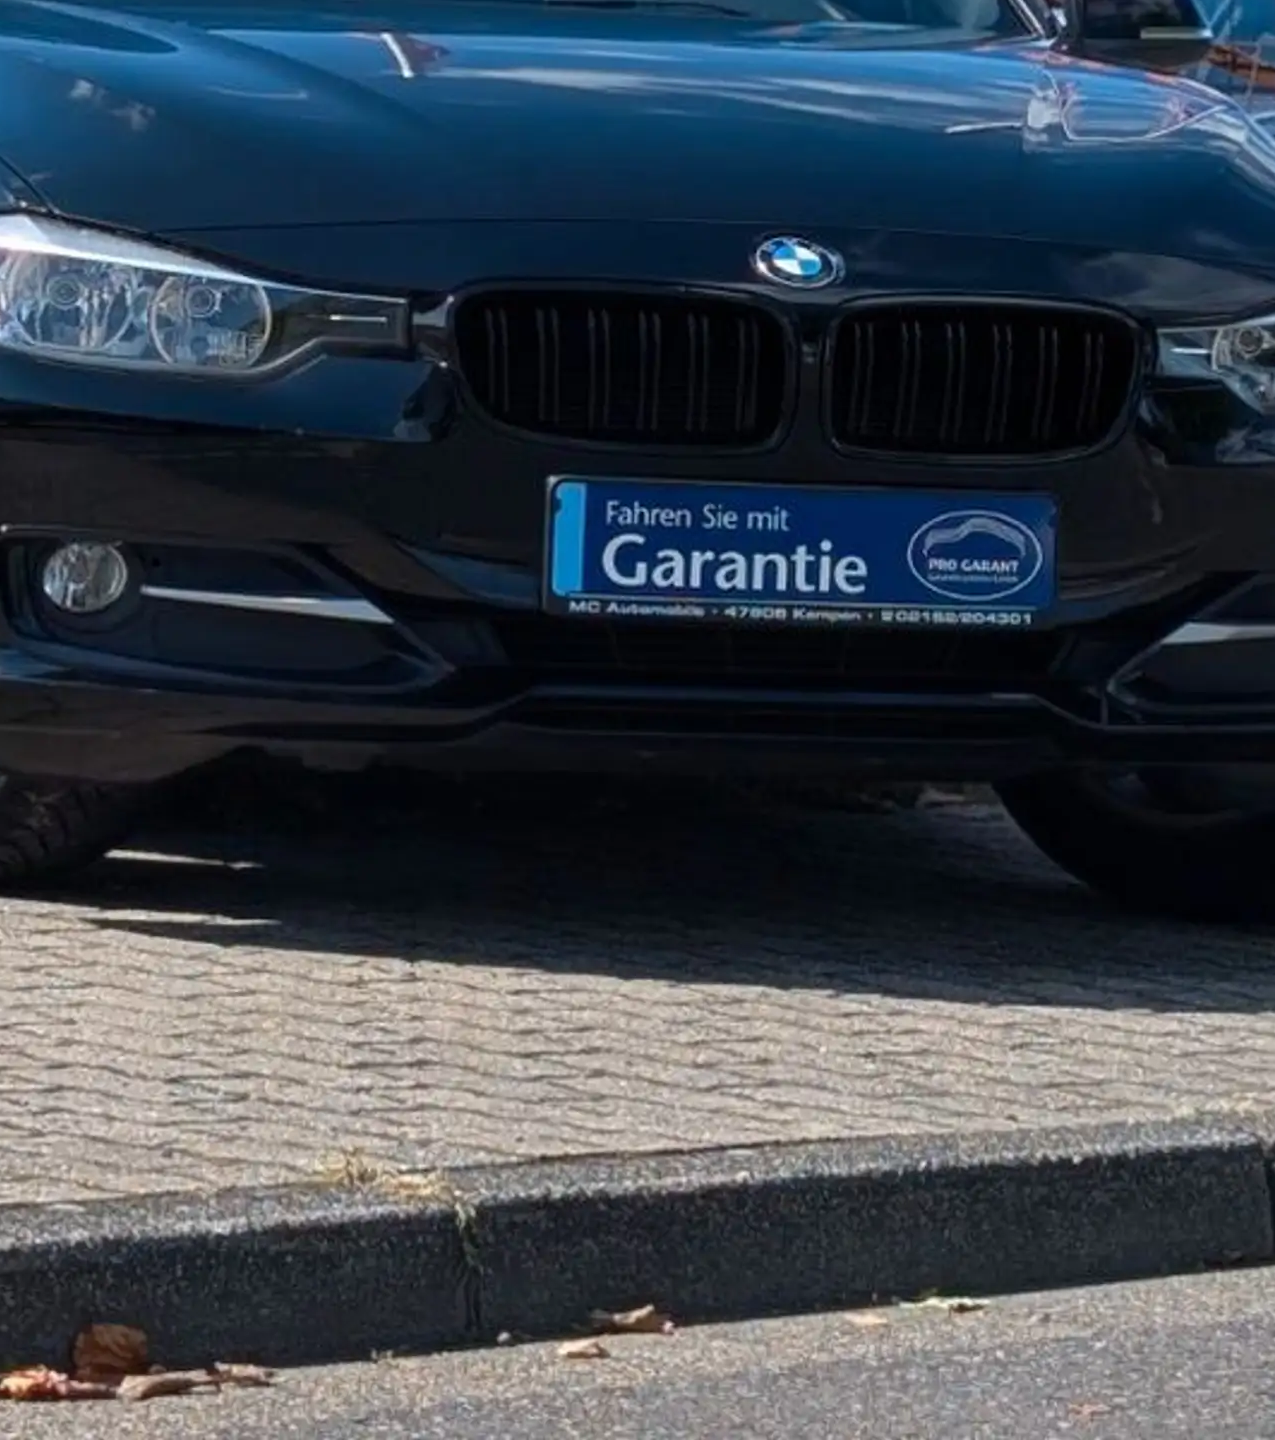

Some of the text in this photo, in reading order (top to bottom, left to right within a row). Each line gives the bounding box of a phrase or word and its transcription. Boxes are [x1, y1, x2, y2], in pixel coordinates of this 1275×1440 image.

[604, 499, 791, 532] Fahren Sie mit
[601, 533, 869, 594] Garantie
